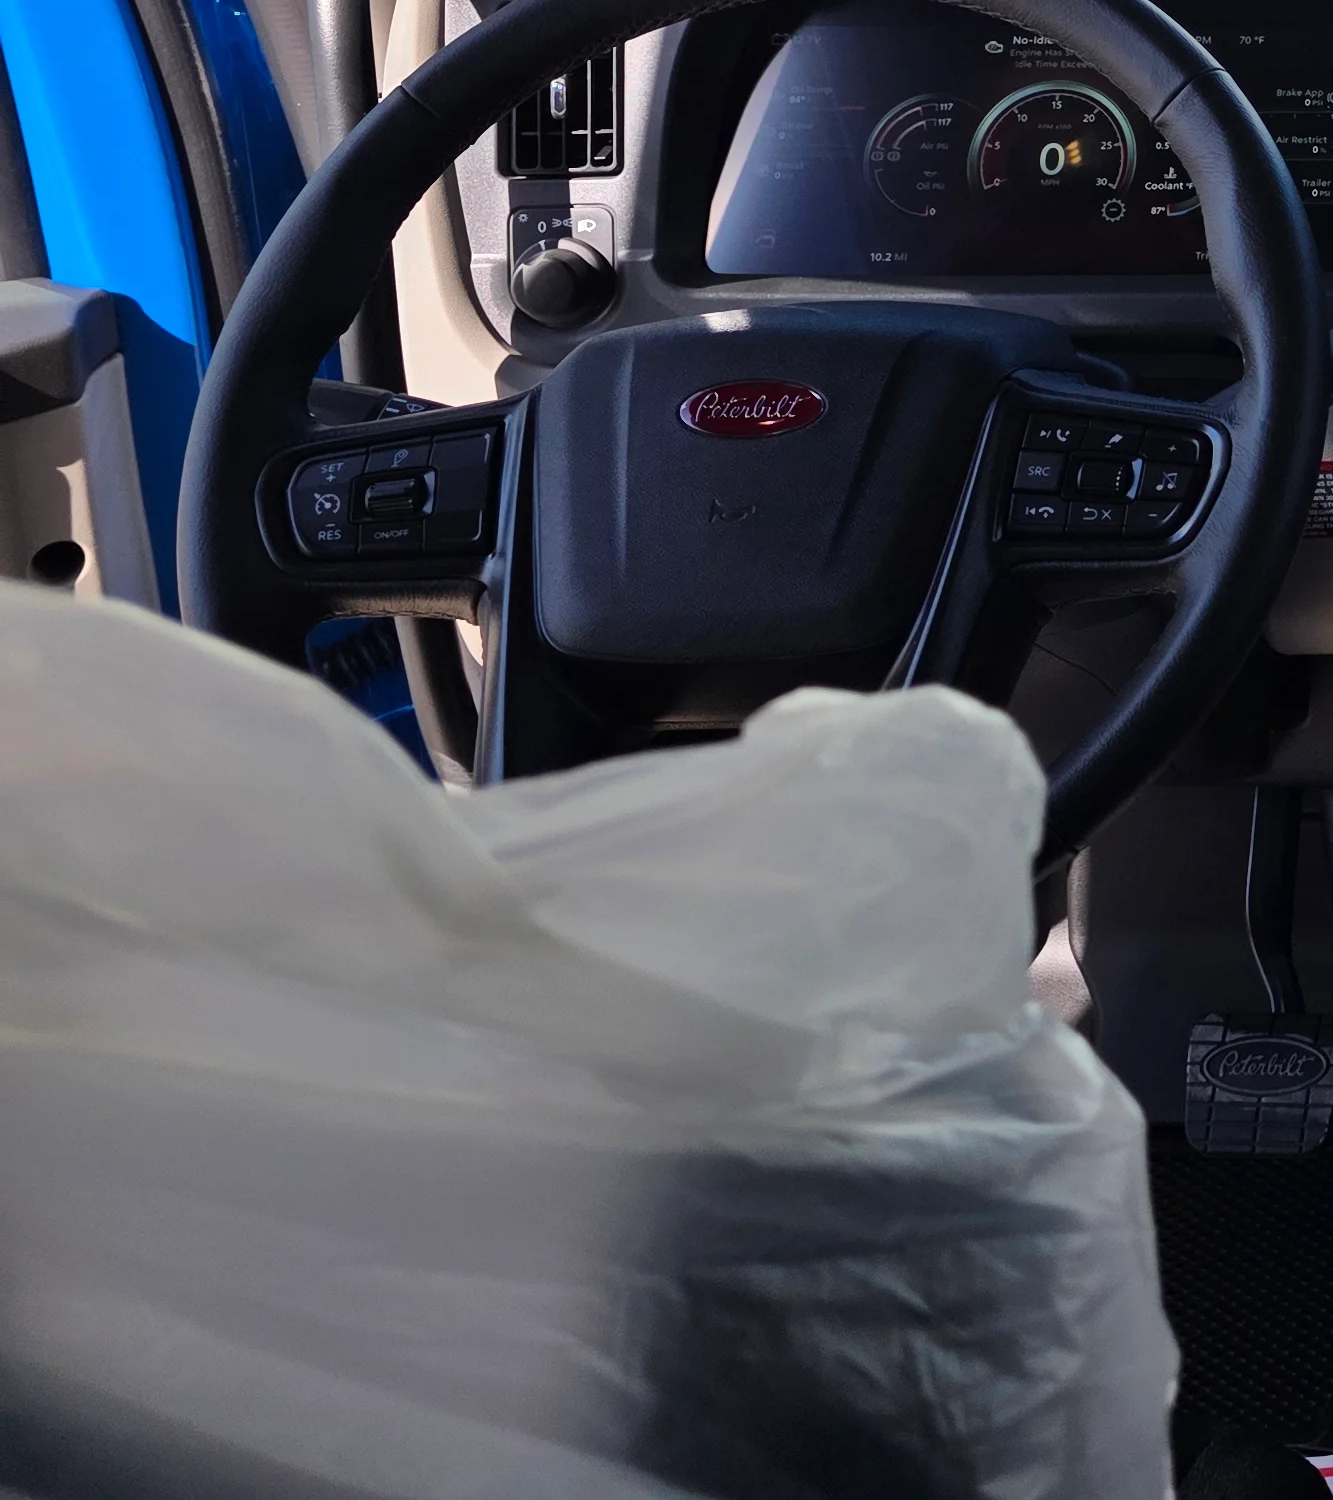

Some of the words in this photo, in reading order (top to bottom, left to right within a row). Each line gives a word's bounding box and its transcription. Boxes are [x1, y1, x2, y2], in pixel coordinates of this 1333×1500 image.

[1239, 36, 1251, 45] 70
[1010, 49, 1042, 59] Engine
[1276, 88, 1302, 97] Brake
[1305, 89, 1324, 99] App
[940, 103, 953, 111] 117
[1051, 101, 1062, 110] 15
[938, 118, 951, 126] 117
[1017, 114, 1028, 122] 10
[1083, 114, 1096, 123] 20
[1276, 136, 1288, 144] Air
[1291, 135, 1327, 144] Restrict
[994, 142, 1001, 150] 5
[1100, 141, 1113, 150] 25
[1039, 143, 1065, 176] 0
[916, 182, 930, 190] Oil
[1040, 179, 1060, 187] MPH
[1096, 178, 1108, 186] 30
[1145, 182, 1184, 191] Coolant
[1302, 179, 1331, 187] Trailer
[1311, 189, 1319, 197] 0
[929, 207, 936, 216] 0
[538, 221, 547, 233] 0
[870, 252, 892, 262] 10.2
[695, 391, 812, 423] Peterbilt
[321, 462, 344, 474] SET
[1027, 466, 1051, 477] SRC
[318, 529, 342, 541] RES
[373, 529, 410, 540] ON/OFF
[1218, 1050, 1315, 1078] Peterbilt
